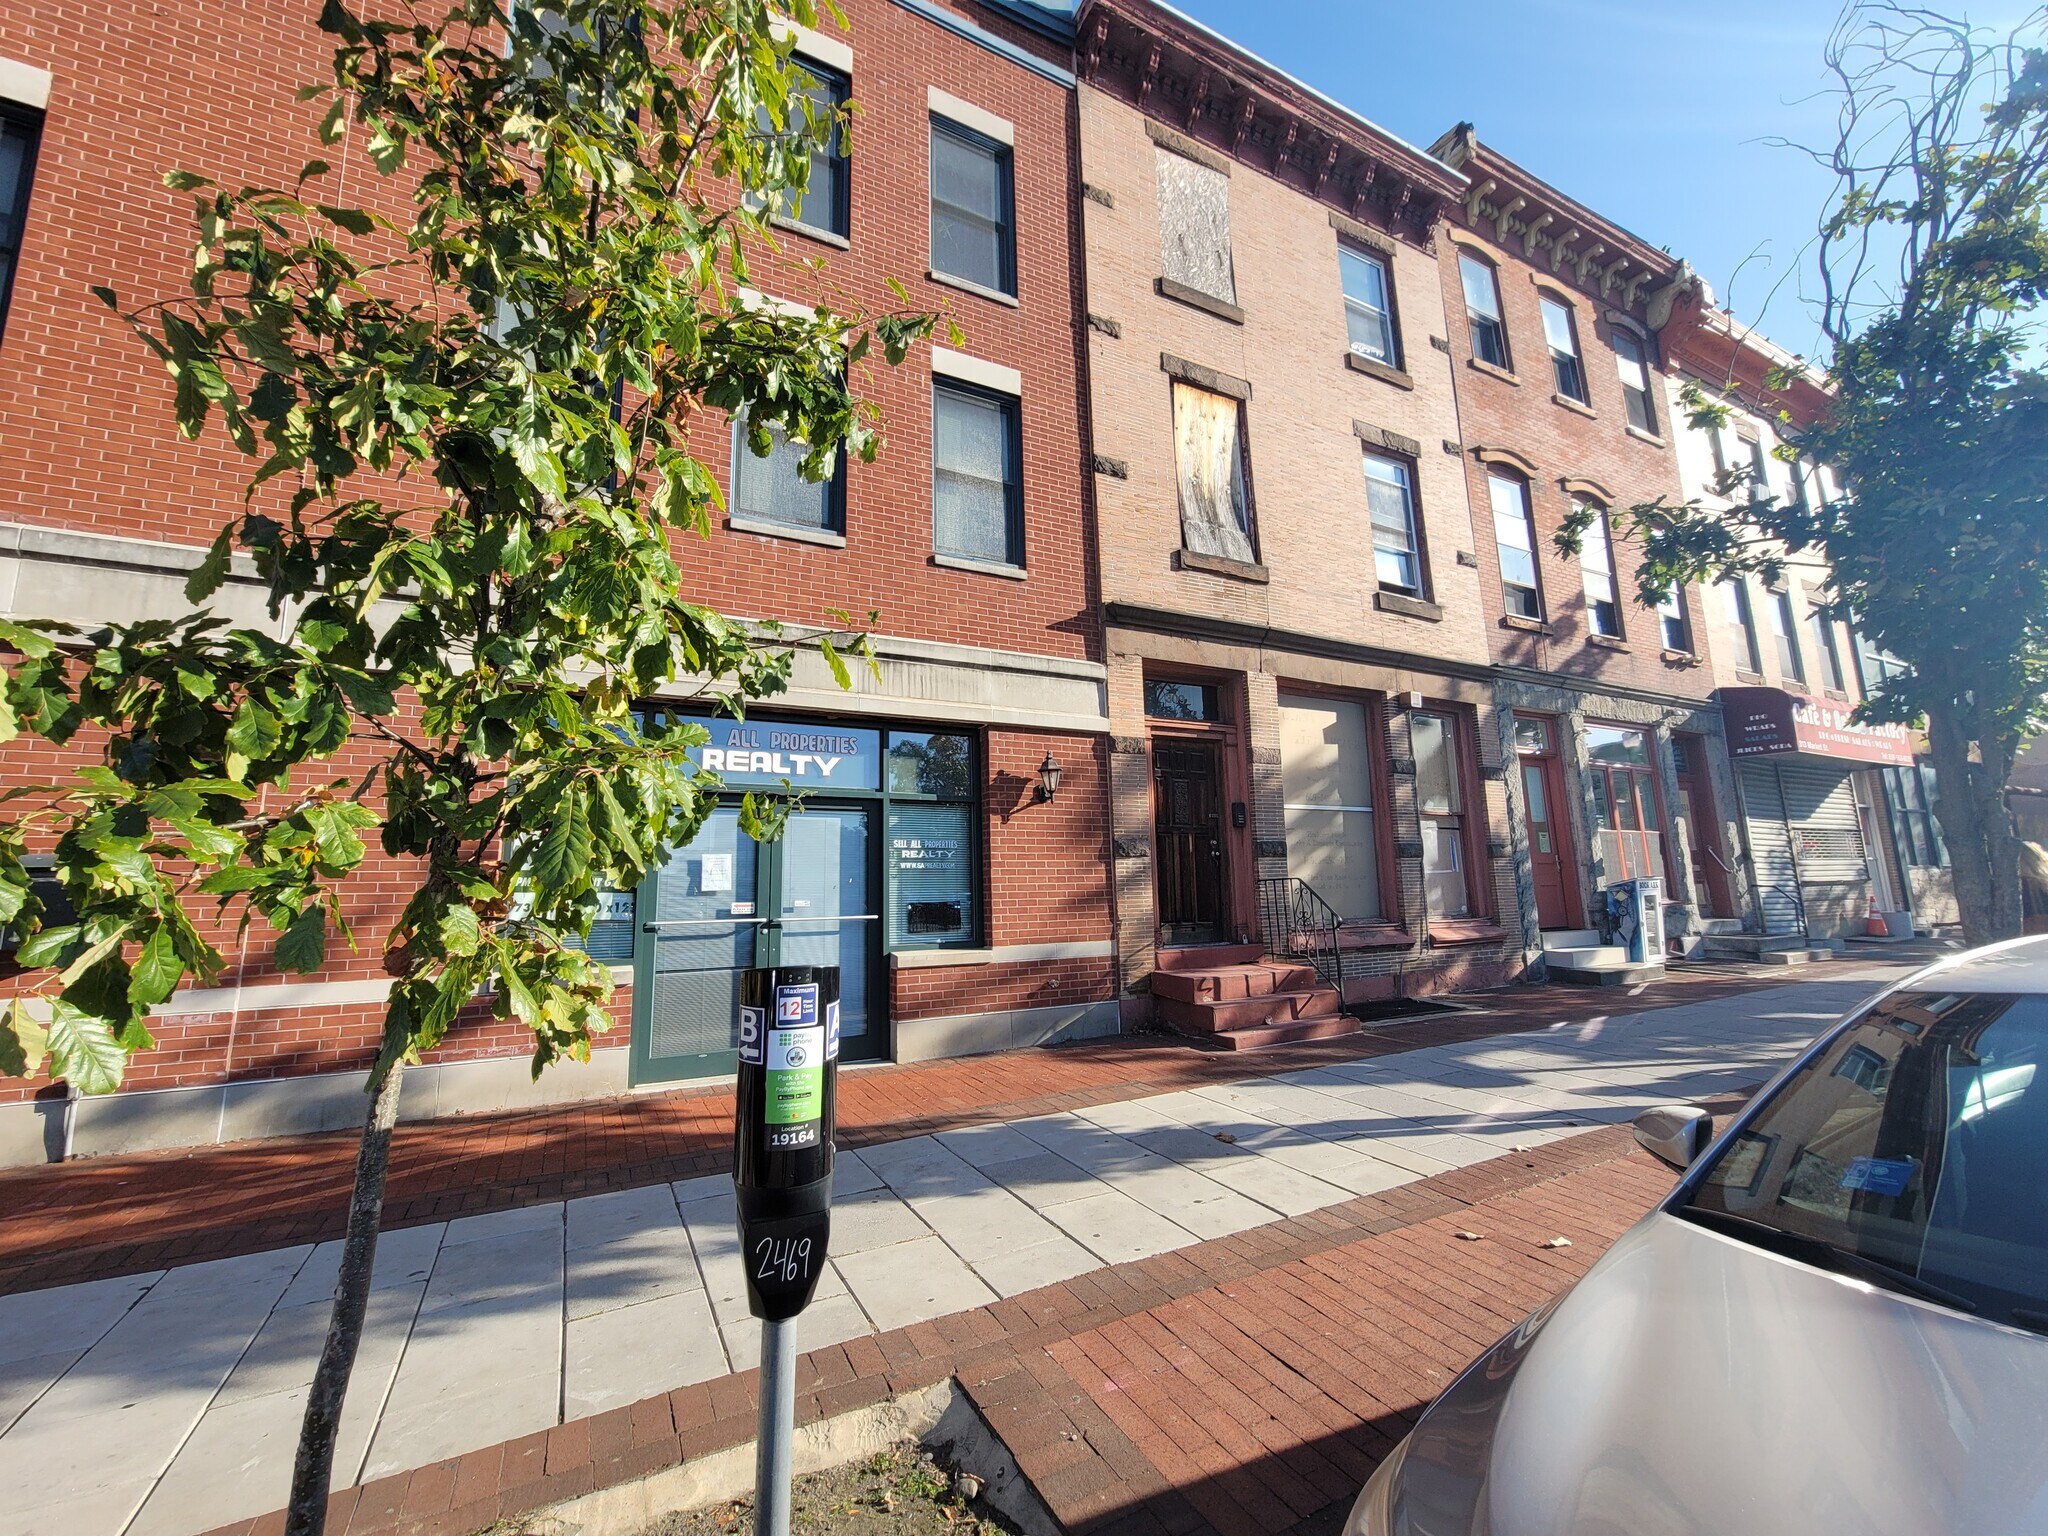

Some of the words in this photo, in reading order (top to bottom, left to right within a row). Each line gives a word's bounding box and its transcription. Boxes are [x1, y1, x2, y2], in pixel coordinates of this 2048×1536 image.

[727, 728, 760, 748] ALL
[770, 732, 858, 755] PROPERTIES
[702, 748, 842, 777] REALTY
[893, 840, 908, 848] SELL
[910, 840, 922, 848] ALL
[924, 840, 958, 848] PROPERTIES
[901, 850, 956, 858] REALTY
[780, 1001, 800, 1016] 12
[741, 1009, 758, 1042] B
[771, 1129, 815, 1146] 19164
[756, 1237, 812, 1282] 2469
